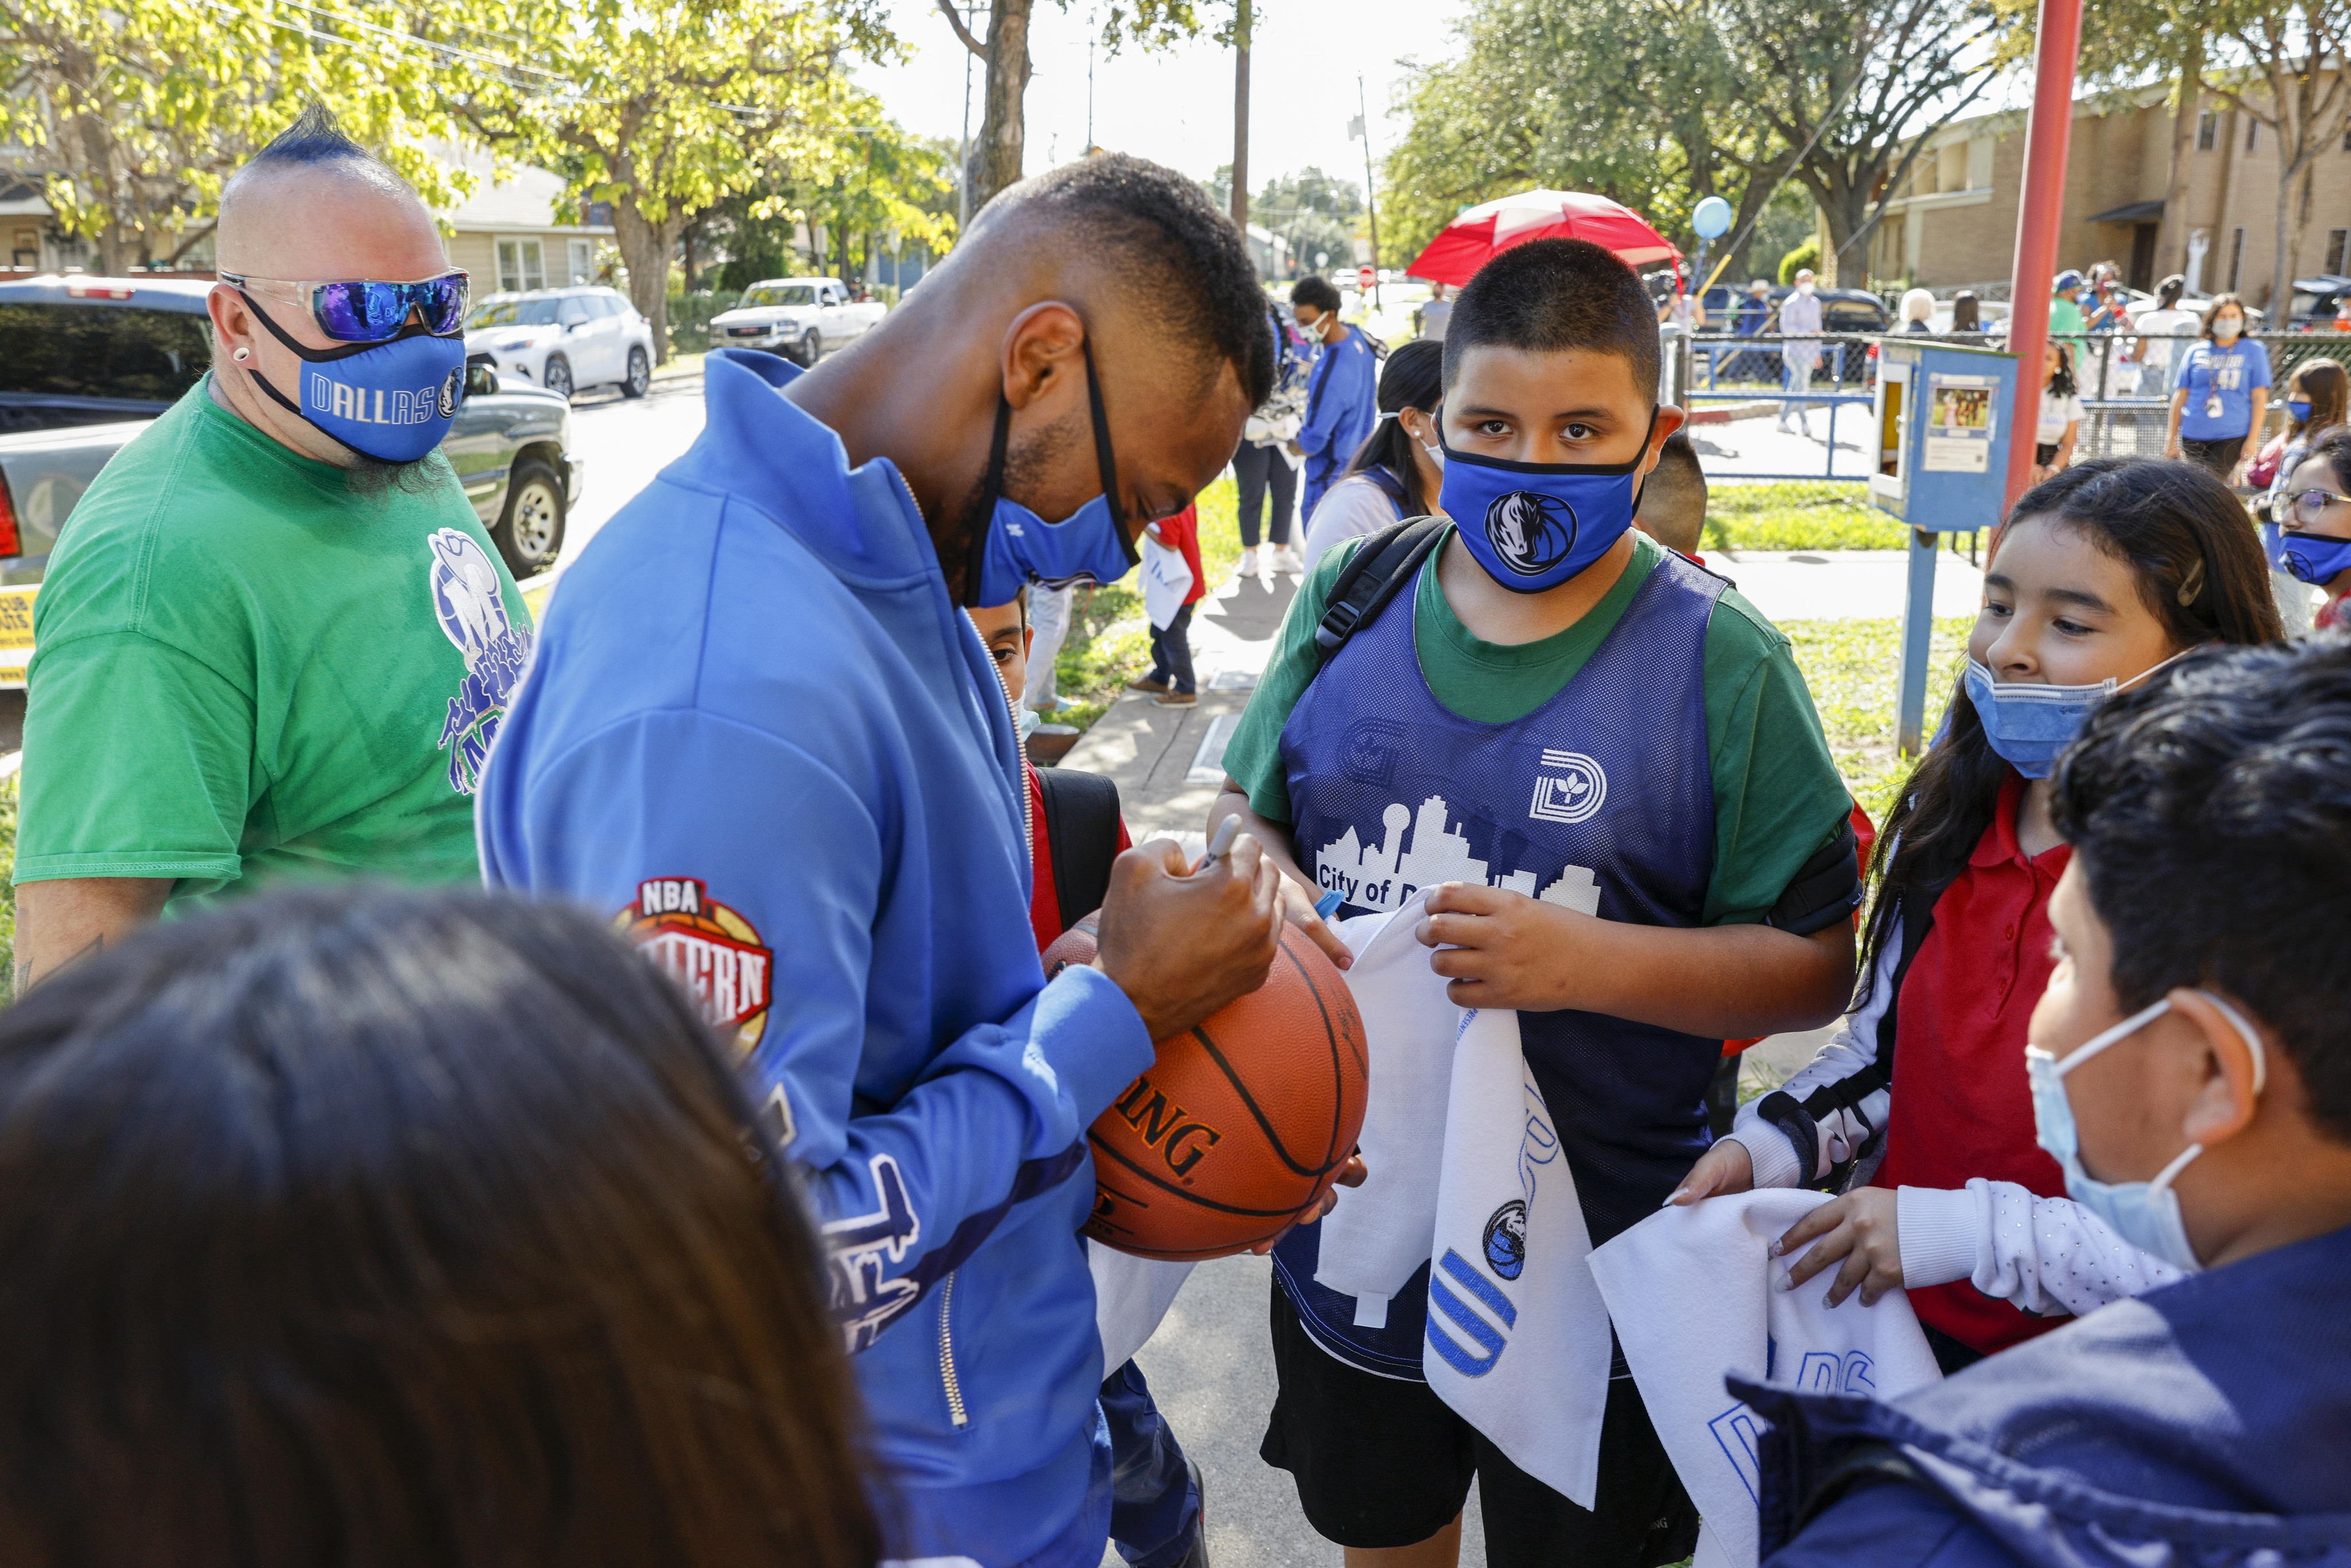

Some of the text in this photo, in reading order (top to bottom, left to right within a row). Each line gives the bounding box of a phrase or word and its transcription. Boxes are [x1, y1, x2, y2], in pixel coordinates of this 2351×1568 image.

[311, 372, 435, 425] DALLAS
[642, 880, 699, 915] NBA
[1320, 864, 1359, 902] City
[1365, 879, 1391, 904] of
[1115, 1074, 1221, 1178] ING
